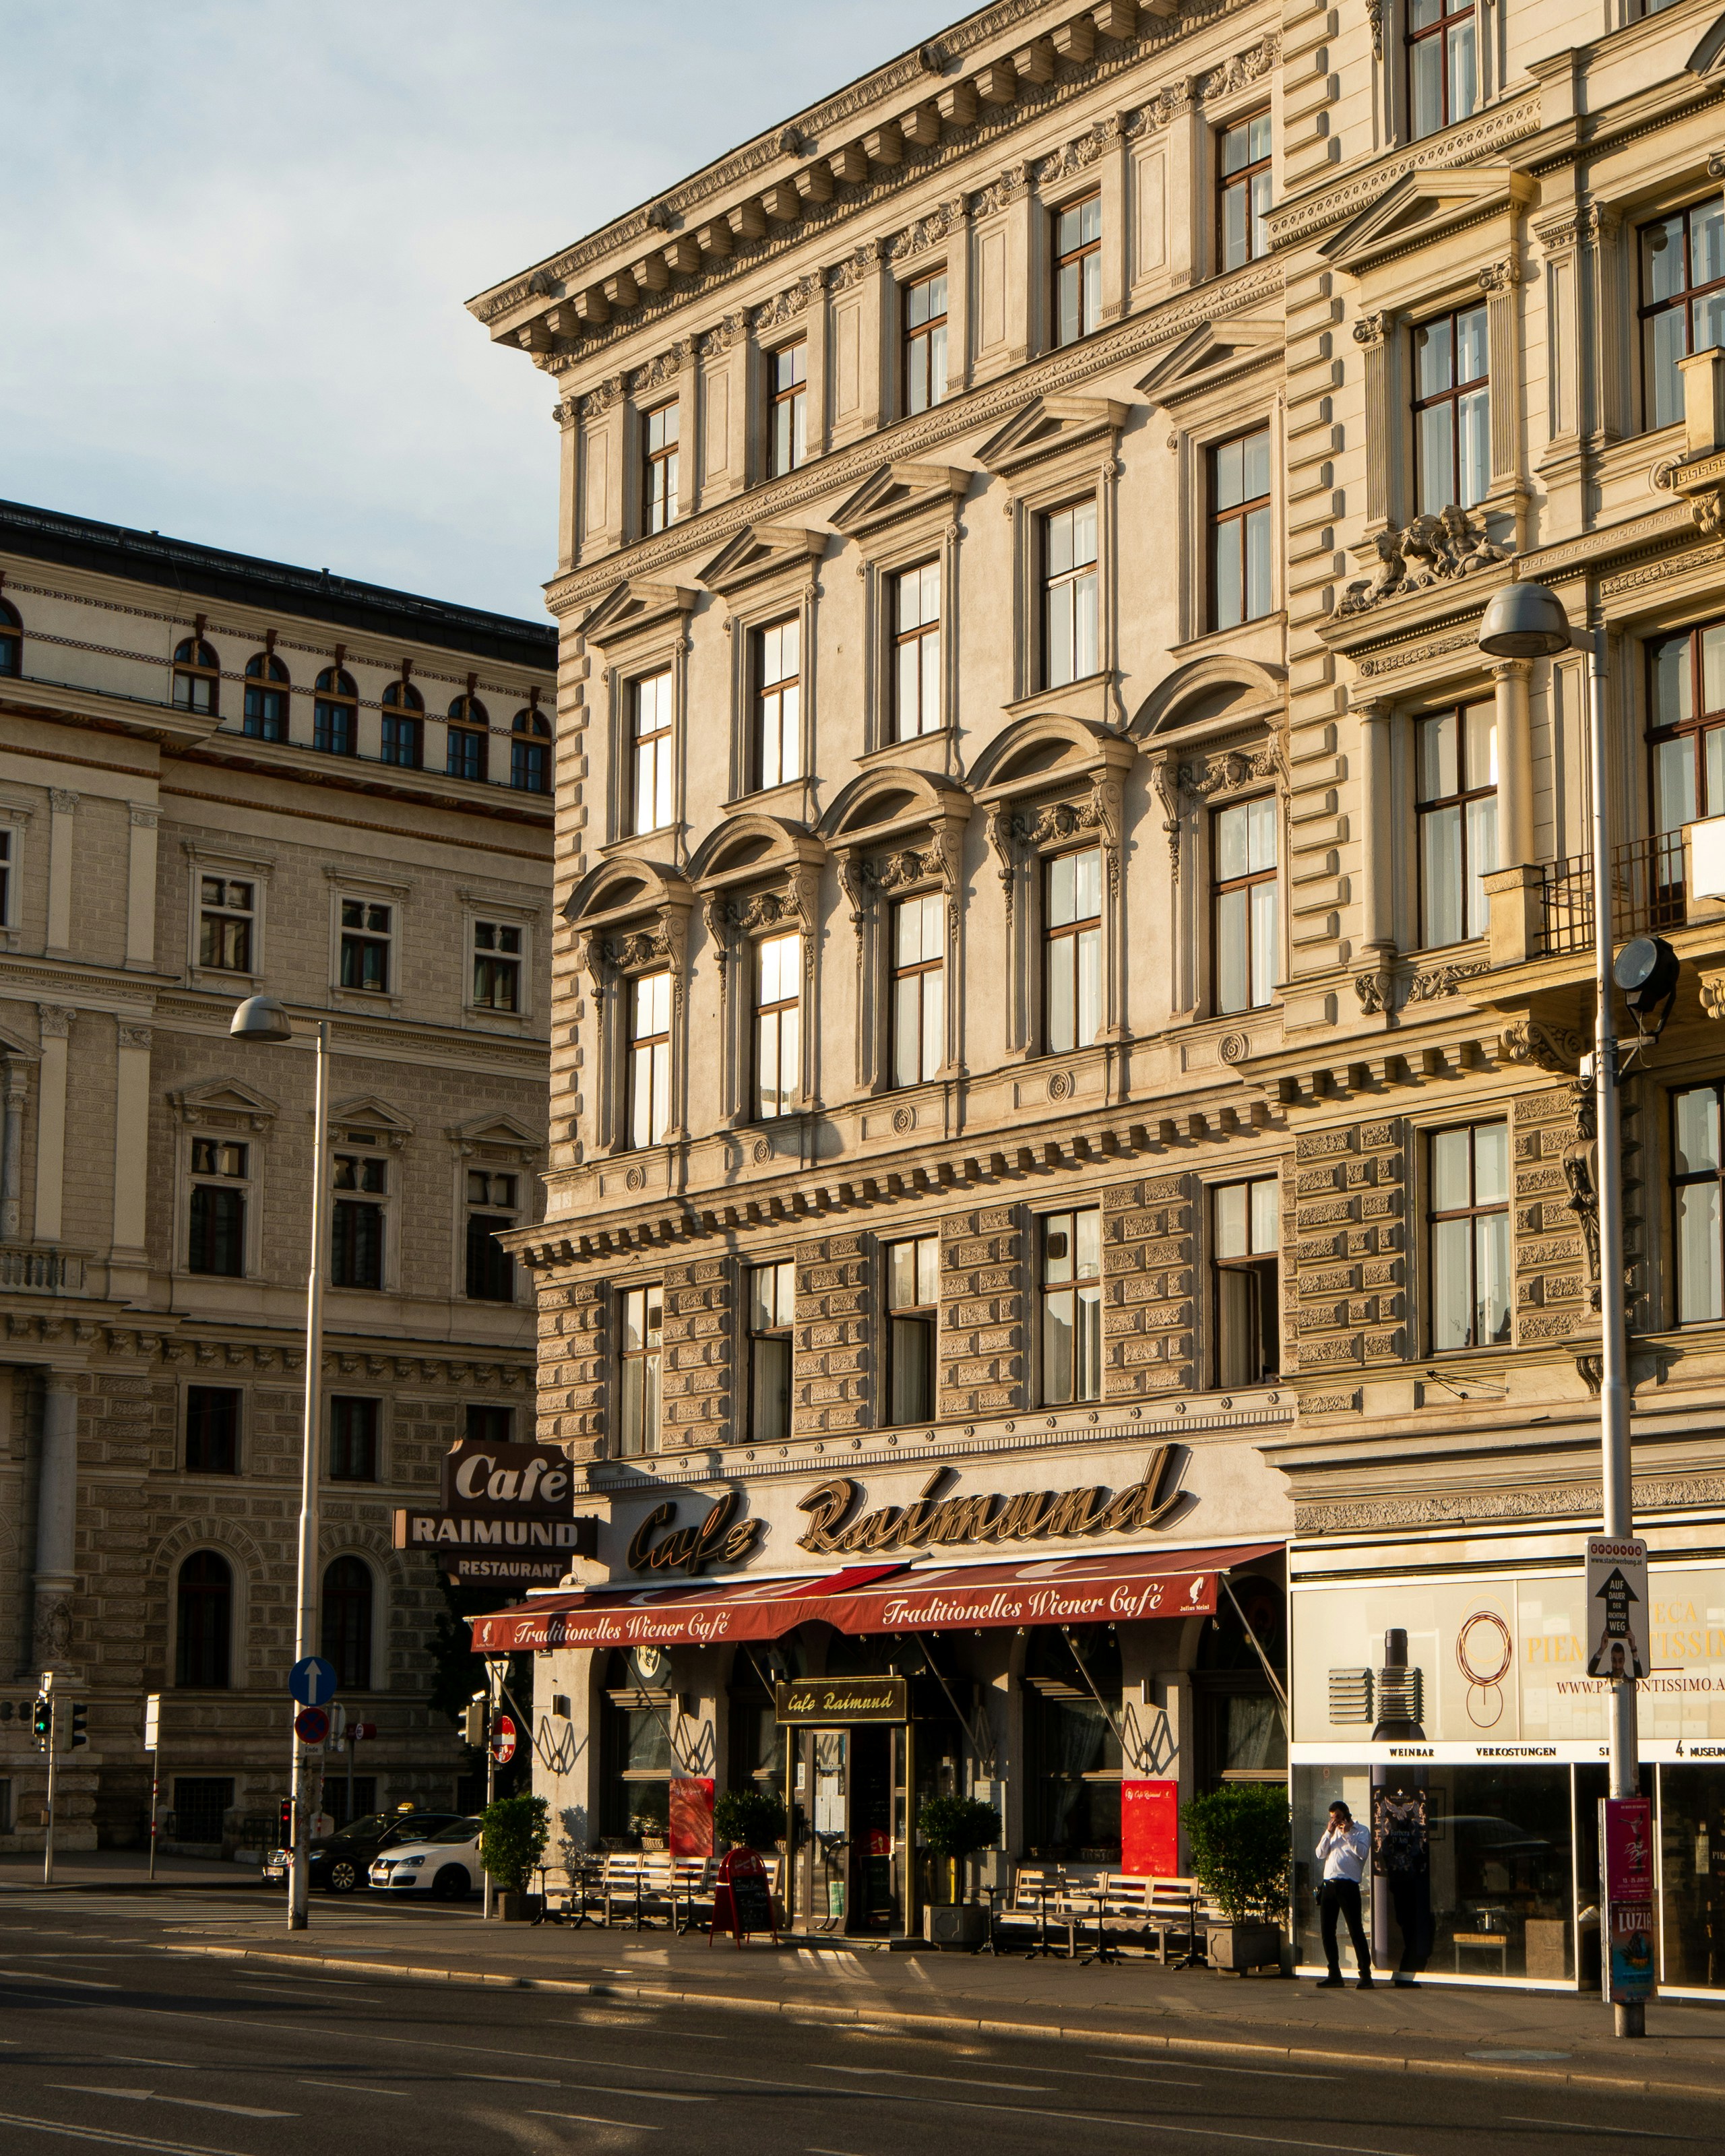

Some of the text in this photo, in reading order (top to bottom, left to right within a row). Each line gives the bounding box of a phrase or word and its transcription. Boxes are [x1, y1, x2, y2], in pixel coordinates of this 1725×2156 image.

[456, 1454, 568, 1502] Café
[626, 1442, 1188, 1576] Cafe Raimund
[412, 1517, 578, 1547] RAIMUND
[459, 1560, 563, 1578] RESTAURANT
[1591, 1557, 1642, 1566] www.stadtwerbung.at
[1610, 1580, 1624, 1589] AUF
[883, 1583, 1164, 1626] Traditionelles Wiener Café
[1608, 1592, 1625, 1600] DAUER
[514, 1612, 732, 1644] Traditionelles Wiener Café
[1609, 1621, 1625, 1631] WEG
[788, 1690, 894, 1712] Cafe Raimund
[1389, 1748, 1435, 1757] WEINBAR
[1476, 1747, 1557, 1756] VERKOSTUNGEN
[1619, 1912, 1652, 1932] LUZIA
